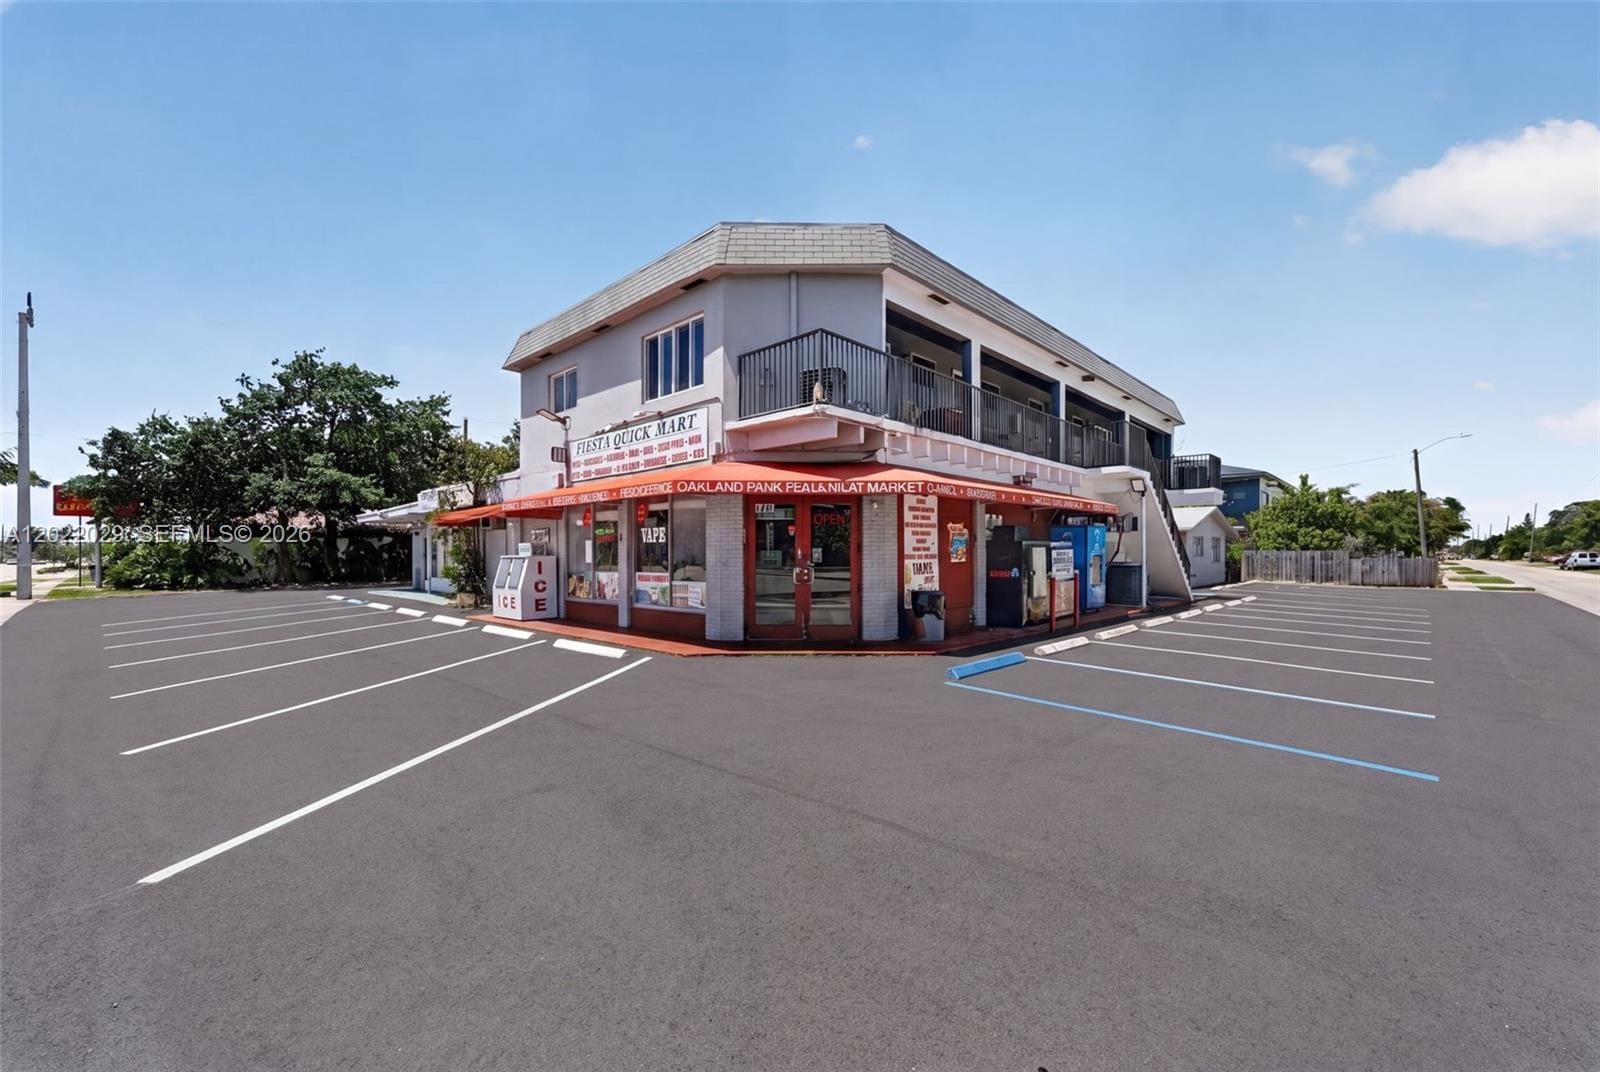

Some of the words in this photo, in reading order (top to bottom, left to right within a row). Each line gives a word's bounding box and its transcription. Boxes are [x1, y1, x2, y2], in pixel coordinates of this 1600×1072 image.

[576, 435, 610, 455] FIESTA
[613, 424, 652, 450] QUICK
[655, 413, 697, 437] MART
[676, 481, 743, 493] OAKLAND
[746, 481, 783, 493] PANK
[867, 482, 924, 493] MARKET
[814, 513, 845, 525] OPEN
[640, 527, 666, 543] VAPE
[534, 560, 547, 612] ICE
[498, 594, 516, 609] ICE
